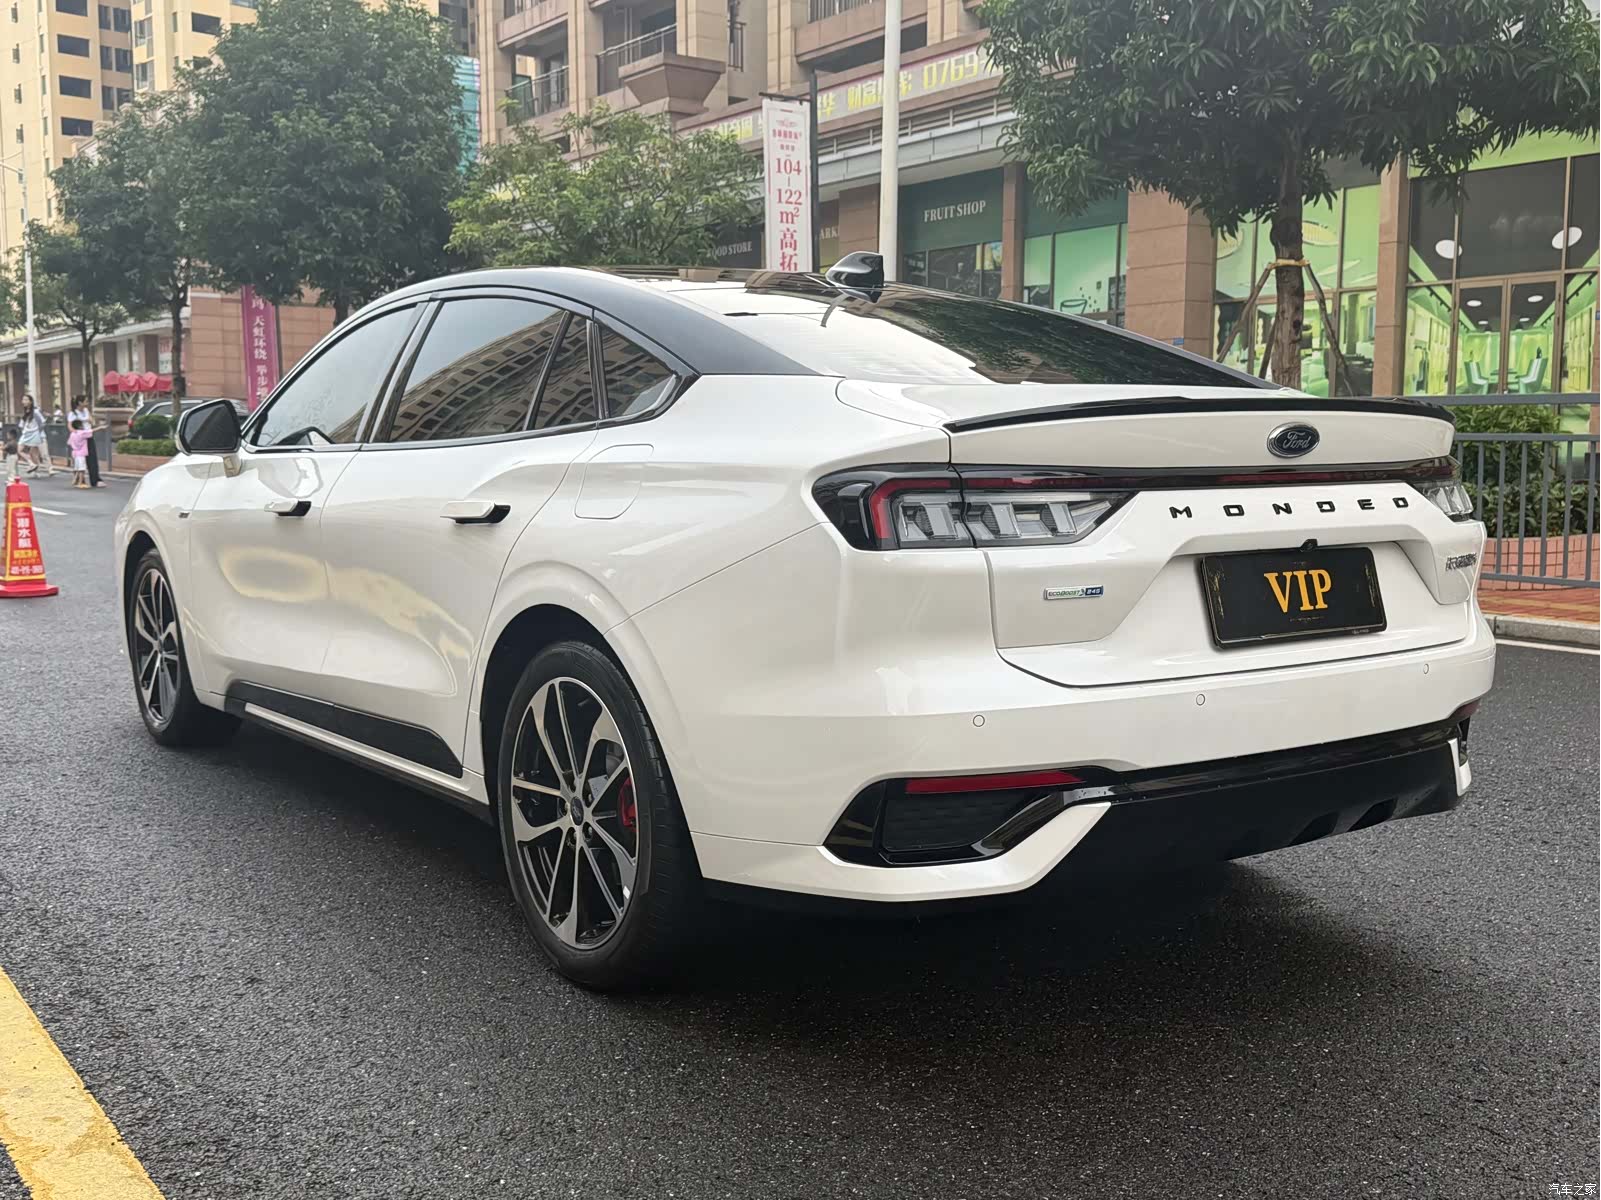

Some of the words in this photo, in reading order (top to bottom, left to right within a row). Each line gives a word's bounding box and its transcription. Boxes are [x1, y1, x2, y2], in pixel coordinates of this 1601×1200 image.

[776, 158, 802, 176] 104
[777, 188, 803, 206] 122
[924, 205, 956, 222] FRUIT
[956, 200, 986, 217] SHOP
[820, 225, 840, 240] ARK
[707, 244, 728, 257] OOD
[728, 240, 753, 255] STORE
[1282, 431, 1312, 449] Ford
[1169, 496, 1409, 519] MONDEO
[1263, 568, 1333, 614] VIP
